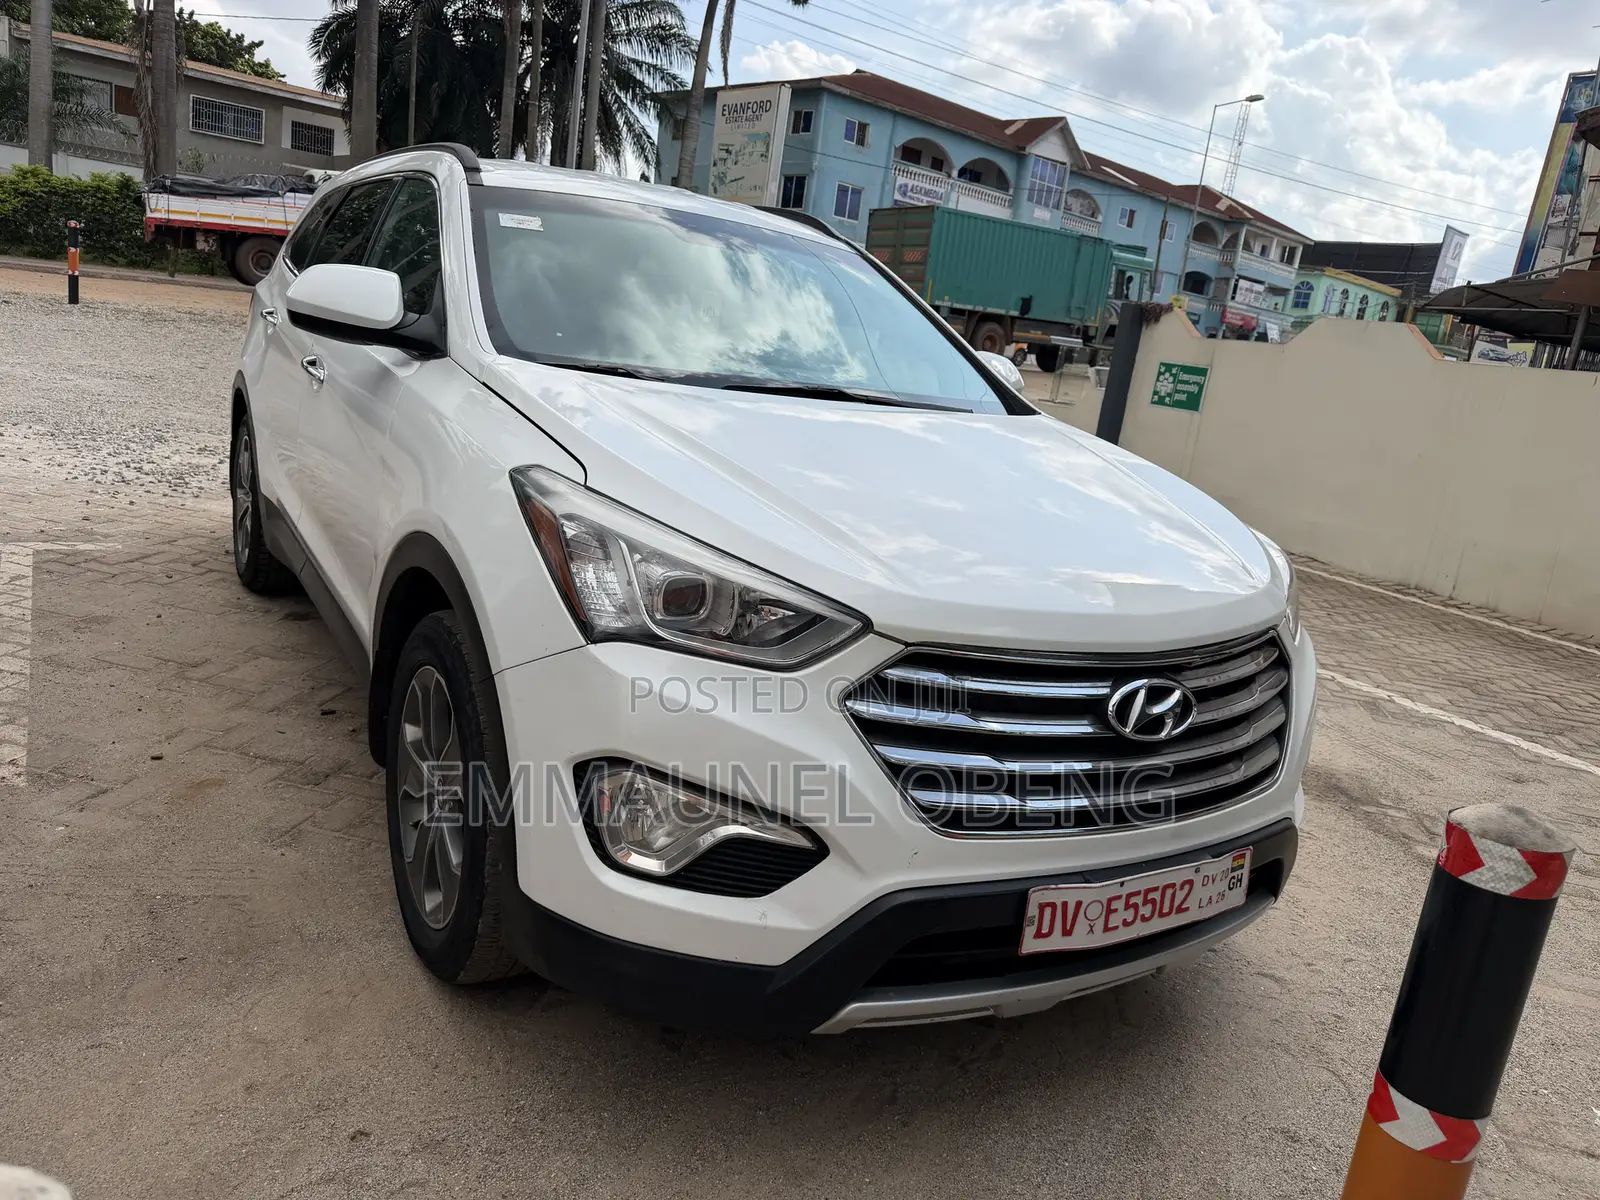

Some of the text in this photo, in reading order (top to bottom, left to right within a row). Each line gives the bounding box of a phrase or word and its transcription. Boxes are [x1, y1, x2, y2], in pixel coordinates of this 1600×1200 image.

[721, 100, 772, 117] EVANFORD
[725, 114, 763, 125] ESTATE AGENT
[730, 122, 756, 132] LIMITED
[909, 184, 943, 201] ASKMEDIA
[1178, 371, 1205, 384] Emergency
[1201, 867, 1230, 887] DV 20
[1227, 872, 1243, 892] GH
[1033, 878, 1195, 939] DV E5502
[1198, 895, 1213, 909] LA
